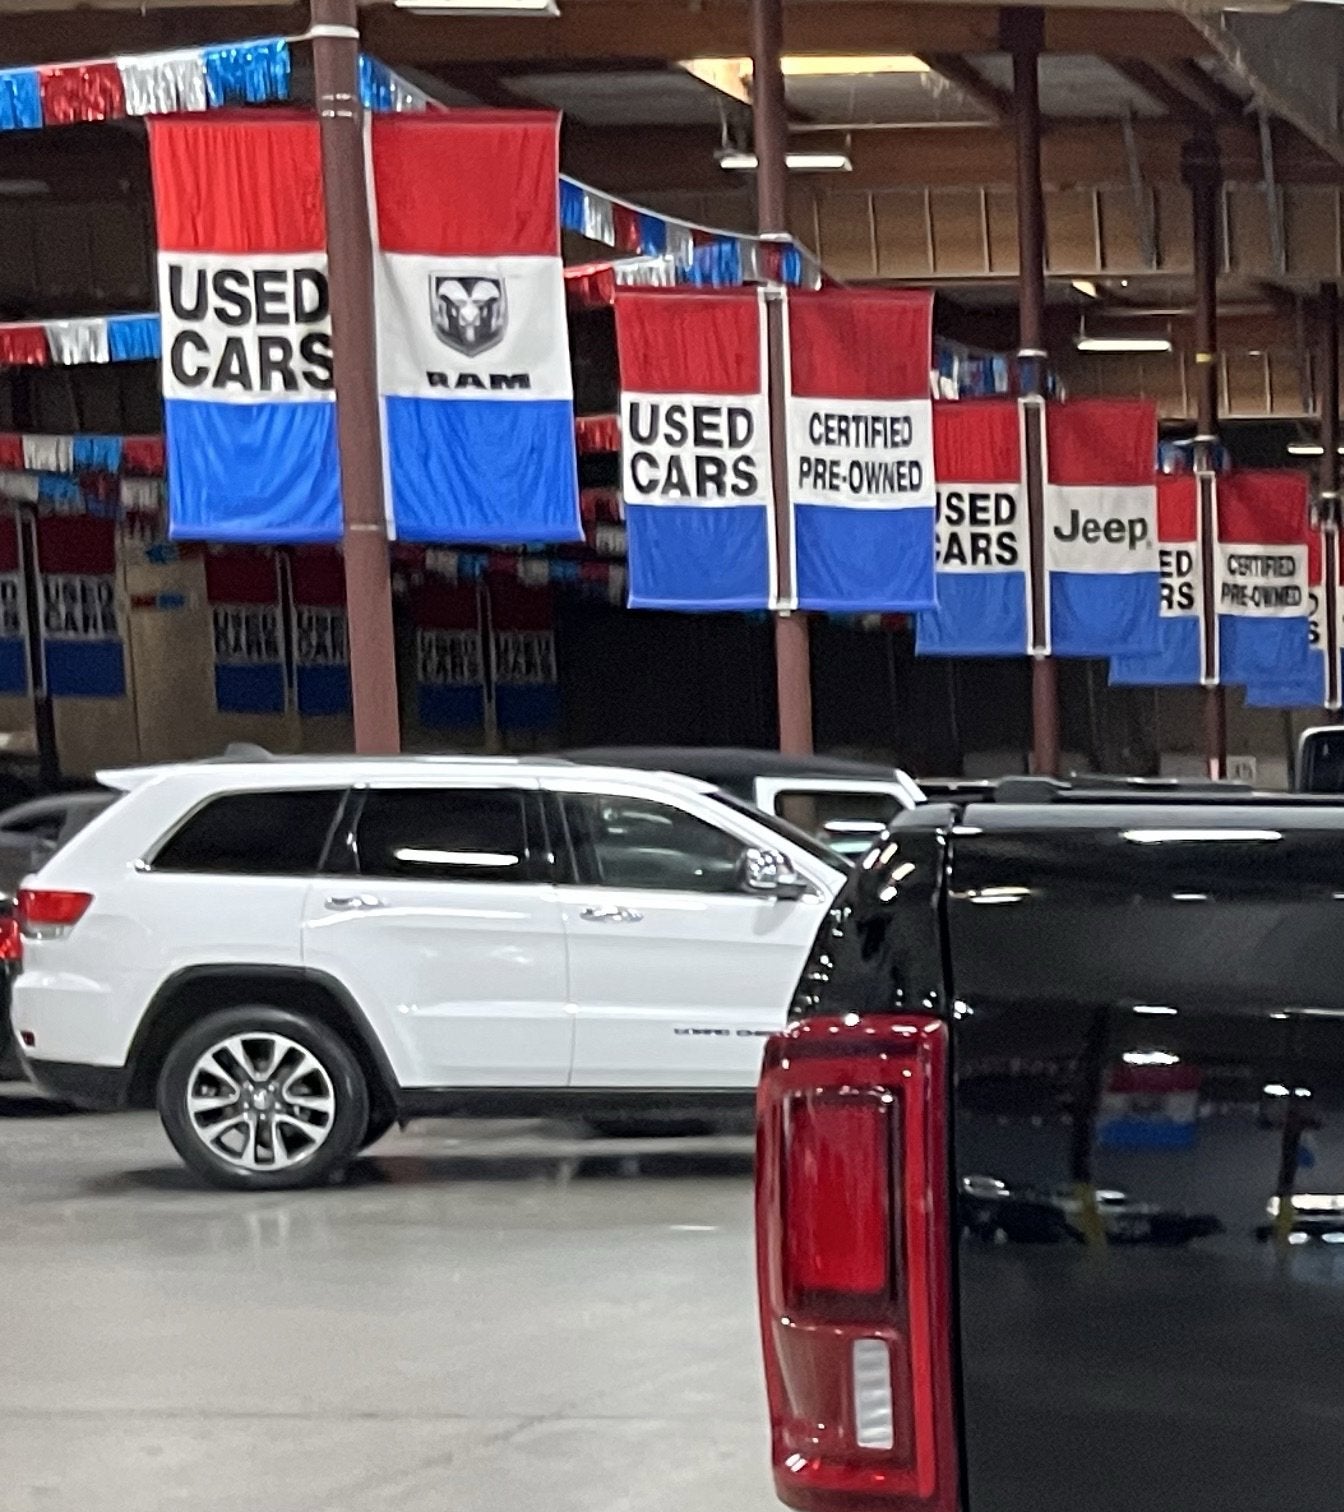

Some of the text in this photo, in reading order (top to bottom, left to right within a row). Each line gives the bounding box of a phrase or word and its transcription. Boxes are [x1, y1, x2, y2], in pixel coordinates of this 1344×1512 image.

[169, 265, 329, 326] USED
[170, 330, 334, 392] CARS
[426, 371, 531, 390] RAM
[629, 402, 755, 449] USED
[808, 412, 912, 449] CERTIFIED
[630, 451, 759, 498] CARS
[799, 456, 923, 494] PRE-OWNED
[936, 491, 1016, 527] SED
[936, 531, 1018, 566] ARS
[1053, 509, 1148, 551] Jeep
[1227, 554, 1296, 578] CERTIFIED
